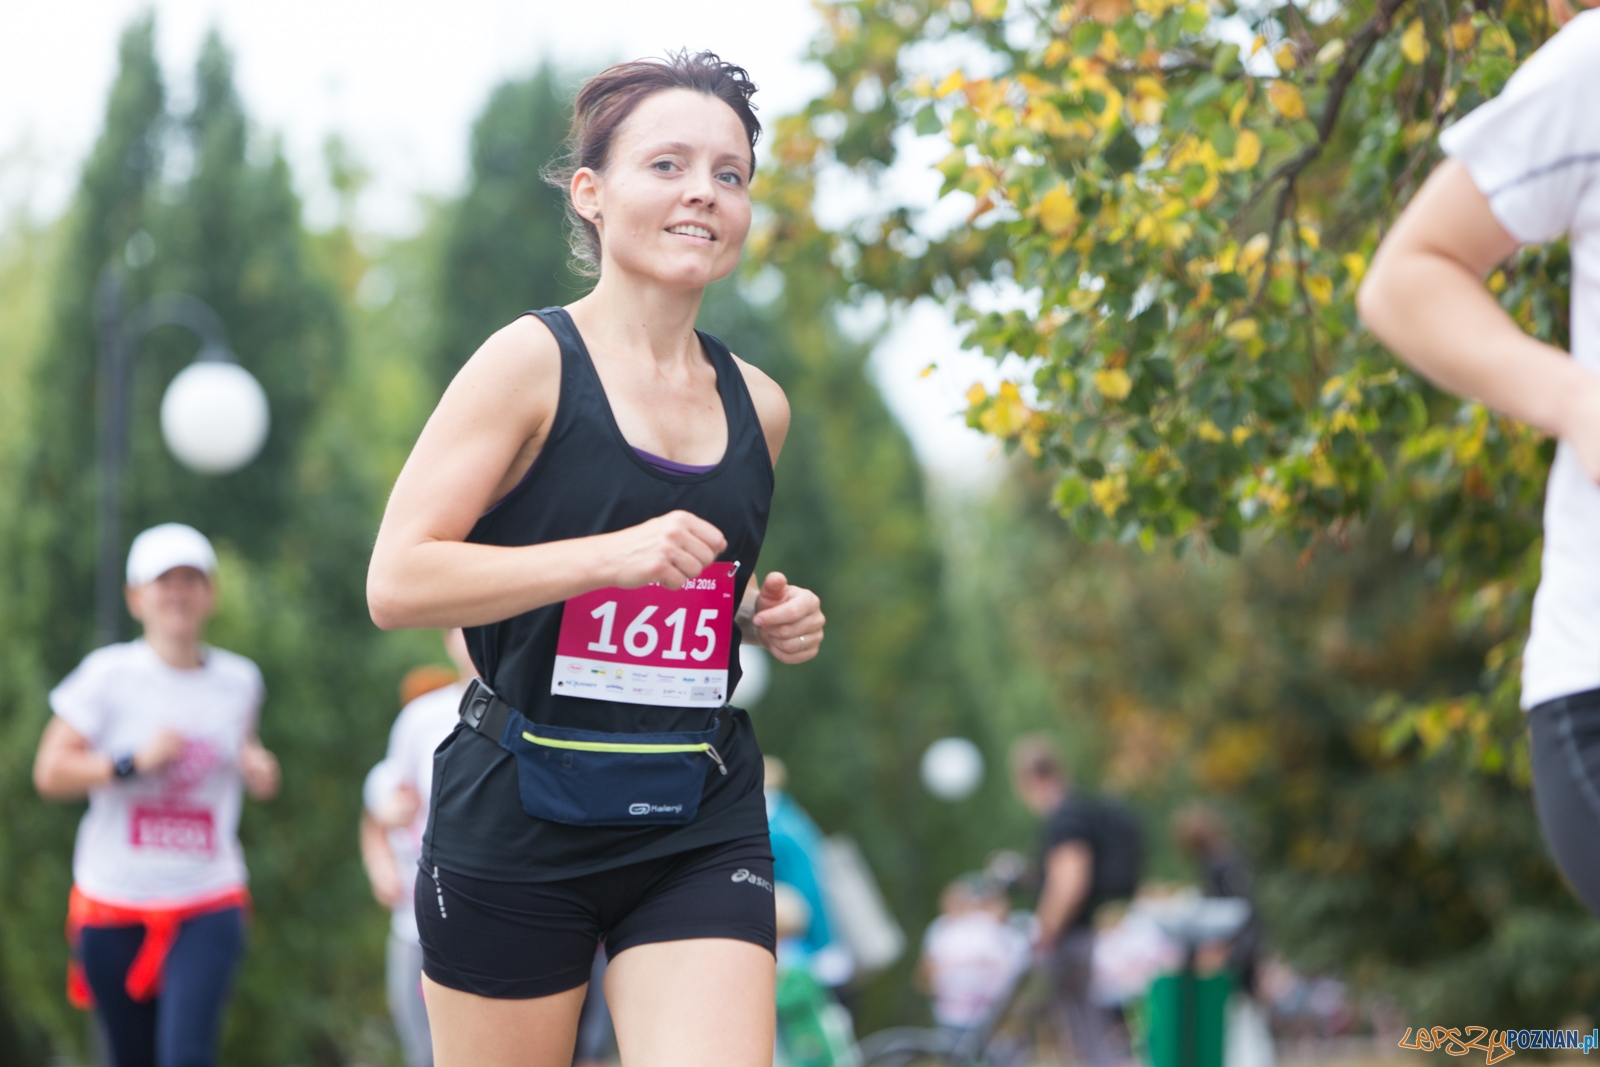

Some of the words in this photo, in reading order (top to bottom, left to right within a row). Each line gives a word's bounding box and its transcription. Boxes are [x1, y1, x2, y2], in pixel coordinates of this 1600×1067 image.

[696, 578, 717, 590] 2016
[587, 600, 719, 662] 1615
[651, 803, 683, 814] Kalenji
